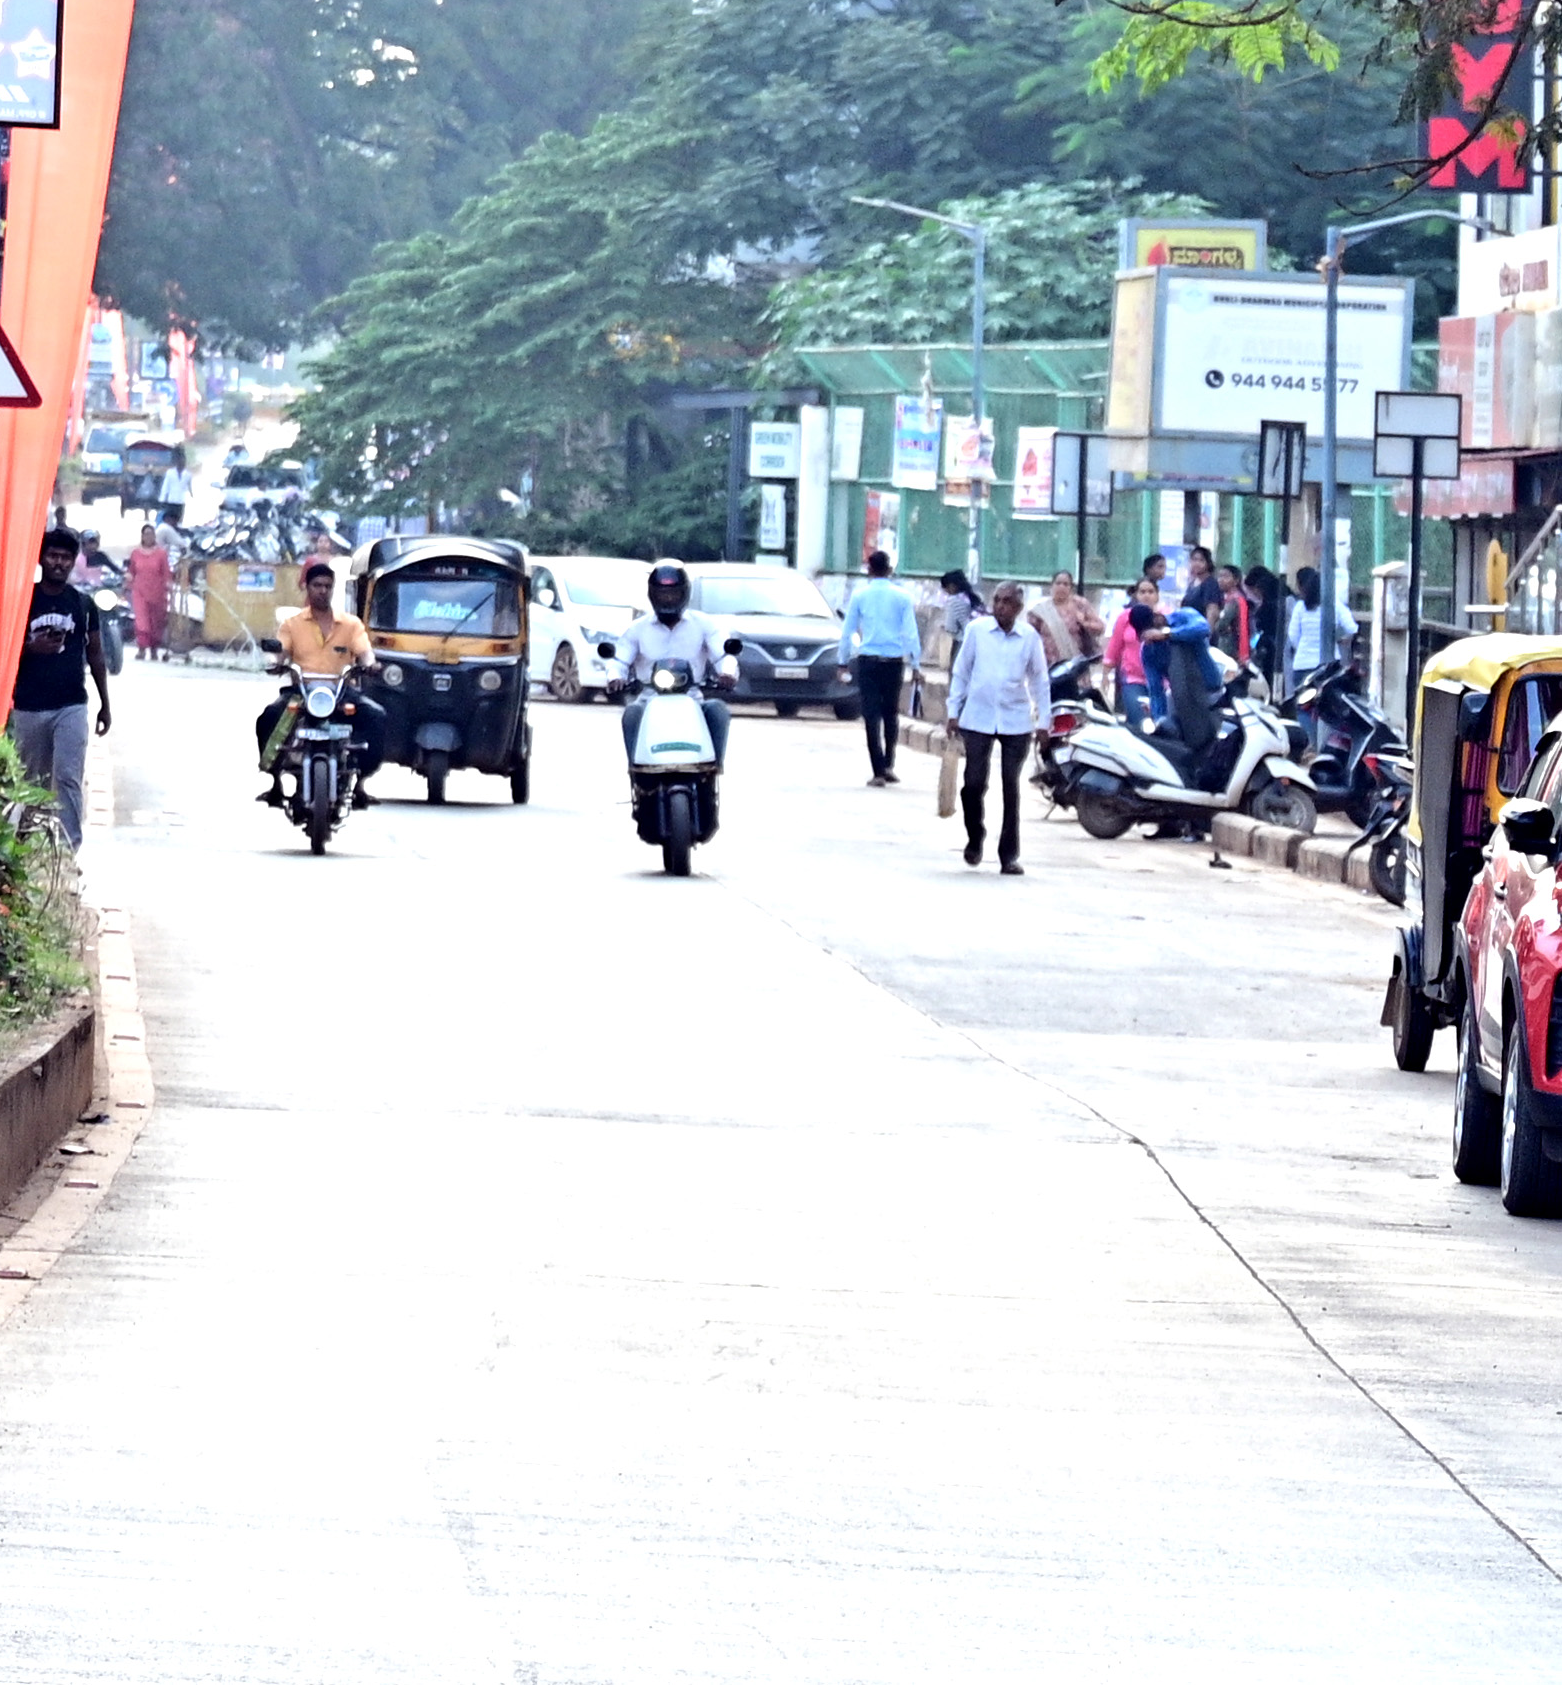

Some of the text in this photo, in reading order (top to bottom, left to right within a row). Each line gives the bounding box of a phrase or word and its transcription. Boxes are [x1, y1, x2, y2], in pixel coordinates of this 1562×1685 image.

[1230, 372, 1360, 394] 944 944 577
